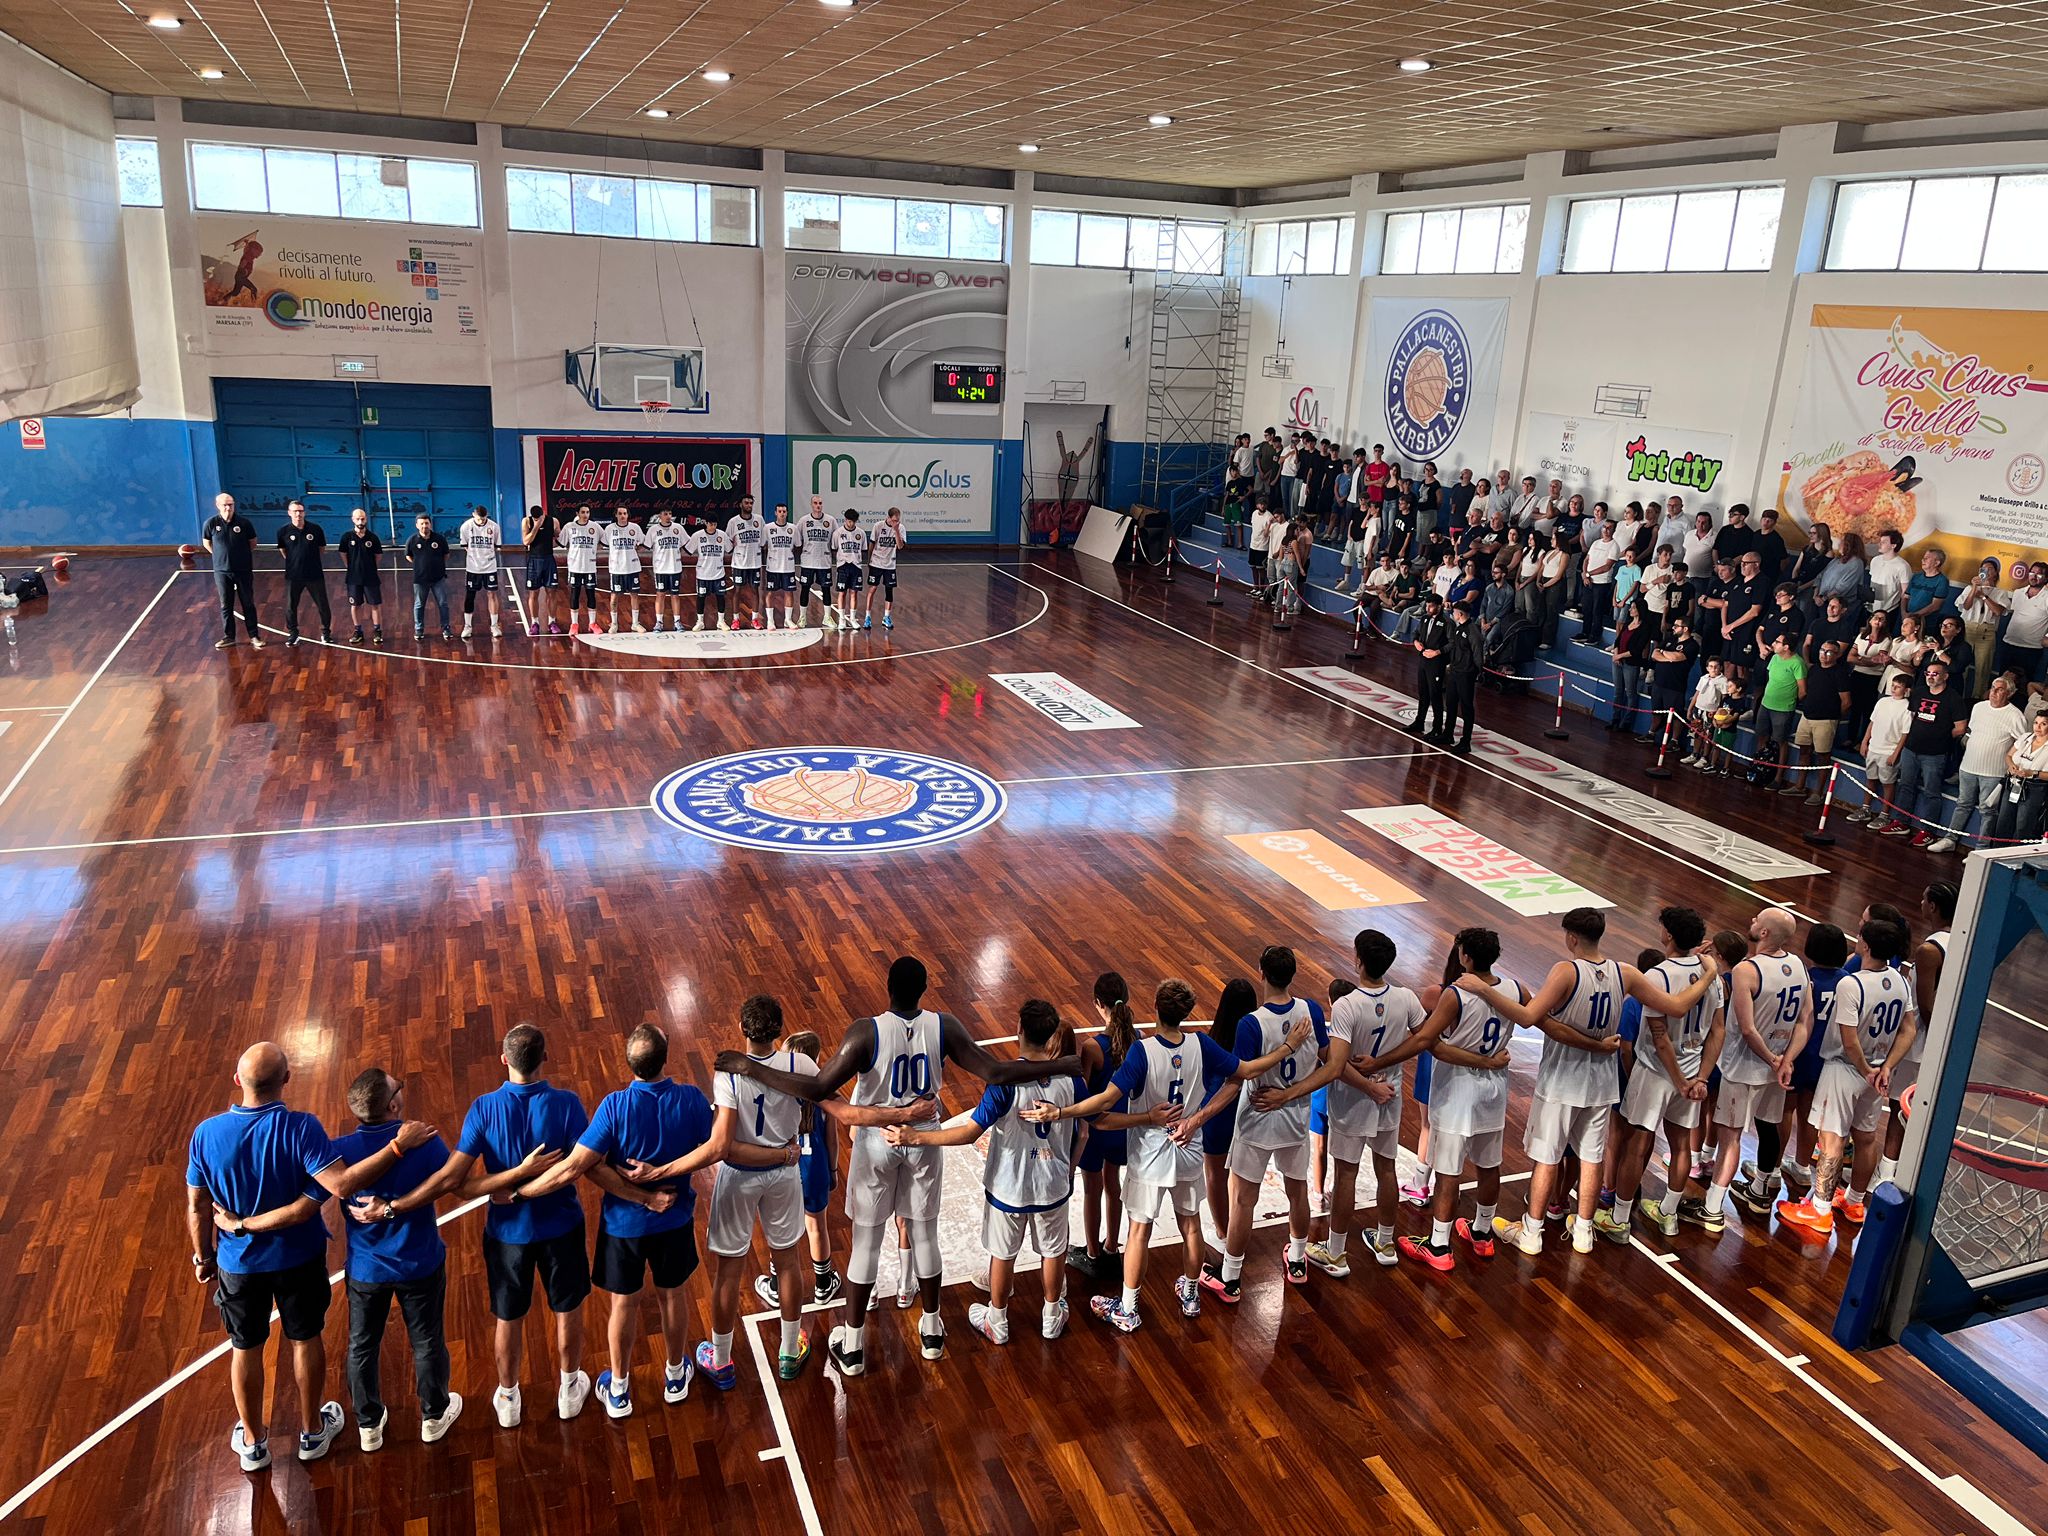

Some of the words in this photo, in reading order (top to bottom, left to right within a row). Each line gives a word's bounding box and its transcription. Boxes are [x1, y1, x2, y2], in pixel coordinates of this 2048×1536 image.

[278, 247, 362, 267] decisamente
[279, 265, 315, 279] rivolti
[320, 267, 333, 281] al
[335, 267, 376, 284] futuro.
[1393, 323, 1464, 389] PALLACANESTRO
[1857, 351, 1934, 389] Cous
[1943, 356, 2027, 398] Cous
[957, 388, 985, 400] 4:24
[986, 374, 994, 386] 0
[1391, 400, 1457, 451] MARSALA
[1883, 396, 1980, 436] Grillo
[1857, 433, 1875, 447] di
[1878, 435, 1928, 457] scaglie
[1930, 441, 1950, 455] di
[1944, 447, 1995, 463] grano
[552, 449, 640, 491] AGATE
[643, 463, 733, 491] COLOR
[731, 463, 742, 482] SRL
[1629, 450, 1669, 482] pet
[1669, 452, 1722, 492] city
[1979, 494, 1997, 503] Molino
[1998, 496, 2023, 507] Giuseppe
[2024, 500, 2039, 509] Grillo
[2008, 518, 2022, 526] 0923
[687, 756, 855, 842] PALLACANESTRO
[853, 754, 978, 835] MARSALA
[1413, 817, 1586, 896] MARKET
[1419, 842, 1544, 901] MEGA
[1295, 852, 1382, 903] expert
[1589, 992, 1611, 1030] 10
[1774, 985, 1802, 1025] 15
[1868, 998, 1903, 1039] 30
[1479, 1017, 1501, 1054] 9
[891, 1052, 931, 1099] 00
[753, 1093, 765, 1137] 1
